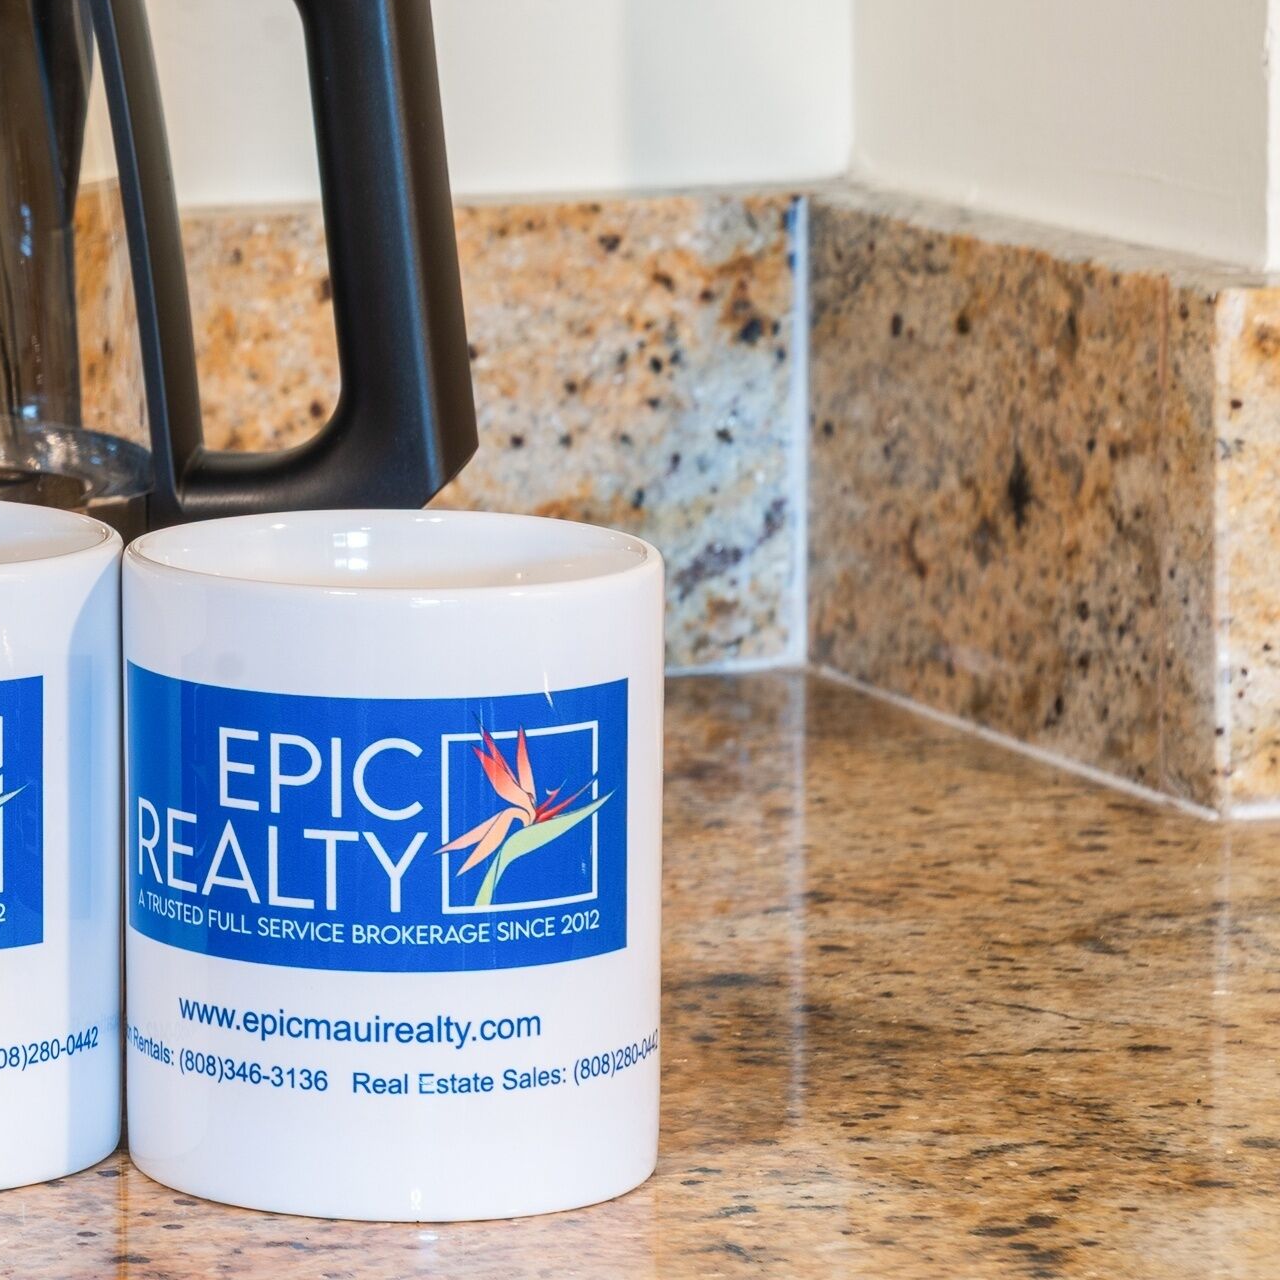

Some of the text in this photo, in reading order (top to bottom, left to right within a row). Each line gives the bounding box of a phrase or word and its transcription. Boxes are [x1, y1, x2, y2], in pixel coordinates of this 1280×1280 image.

[219, 726, 424, 821] EPIC
[138, 796, 429, 913] REALTY
[138, 888, 600, 945] A TRUSTED FULL SERVICE BROKERAGE SINCE 2012
[178, 996, 542, 1049] www.epicmauirealty.com
[133, 1026, 174, 1066] Rentals:
[179, 1048, 328, 1092] (808)346-3136
[352, 1072, 408, 1095] Real
[418, 1070, 494, 1095] Estate
[502, 1066, 566, 1091] Sales:
